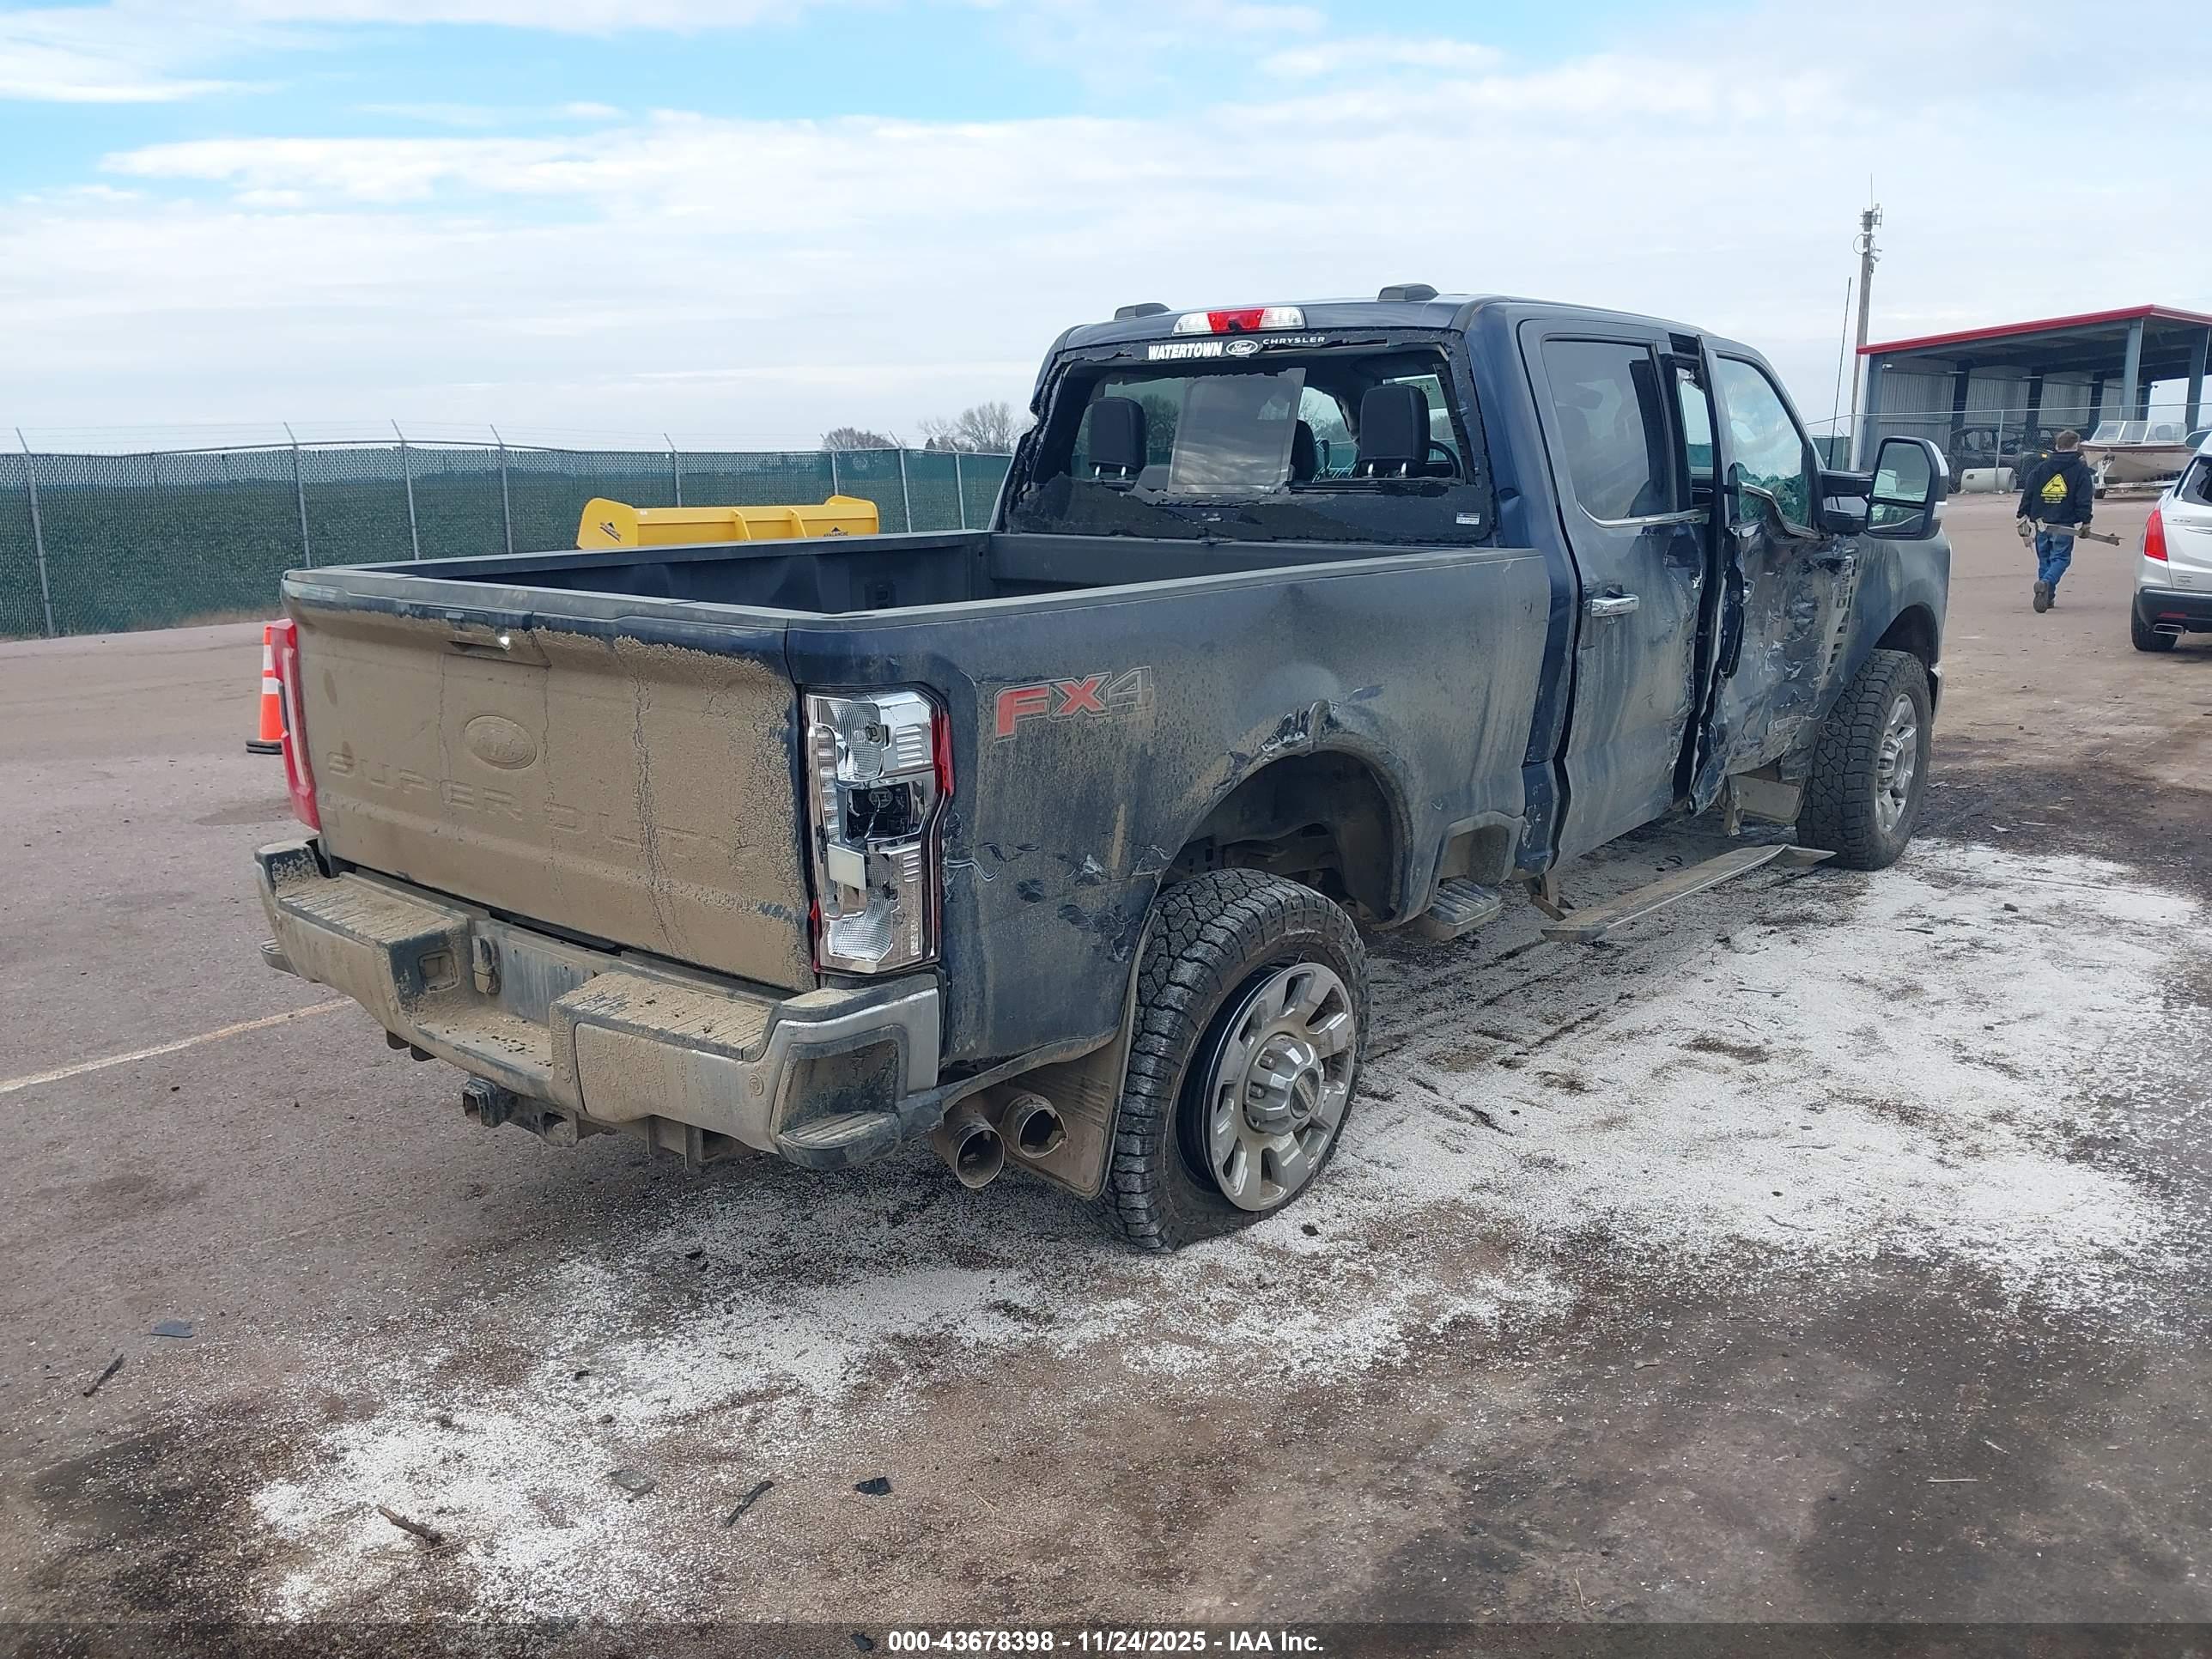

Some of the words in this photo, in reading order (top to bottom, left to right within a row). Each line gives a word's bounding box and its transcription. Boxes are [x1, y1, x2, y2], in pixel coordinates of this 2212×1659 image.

[1148, 342, 1223, 360] WATERTOWN
[1229, 342, 1255, 353] Ford
[994, 666, 1154, 744] FX4
[326, 750, 524, 822] SUPER
